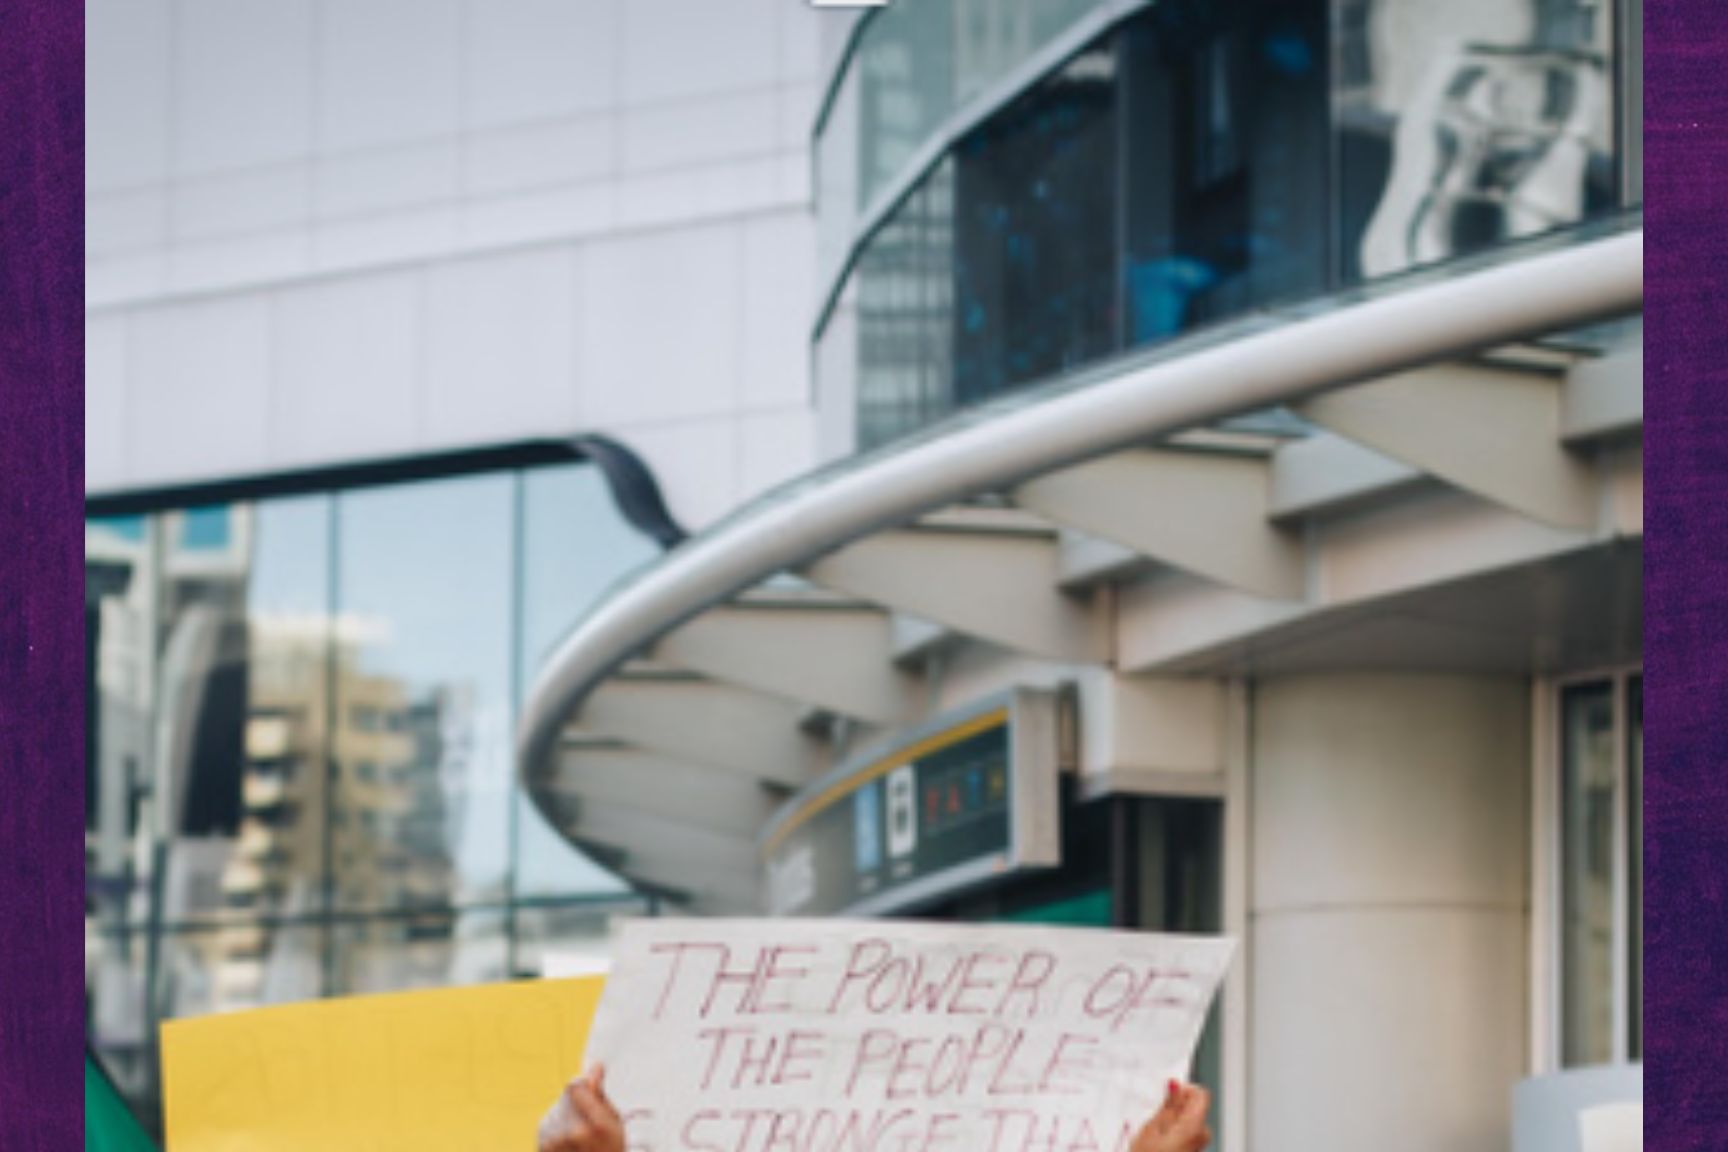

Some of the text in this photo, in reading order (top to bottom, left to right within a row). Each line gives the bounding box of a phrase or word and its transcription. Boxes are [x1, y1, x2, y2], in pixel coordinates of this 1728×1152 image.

[650, 937, 1188, 1032] THE POWER OF
[697, 1022, 1099, 1099] THE PEOPLE
